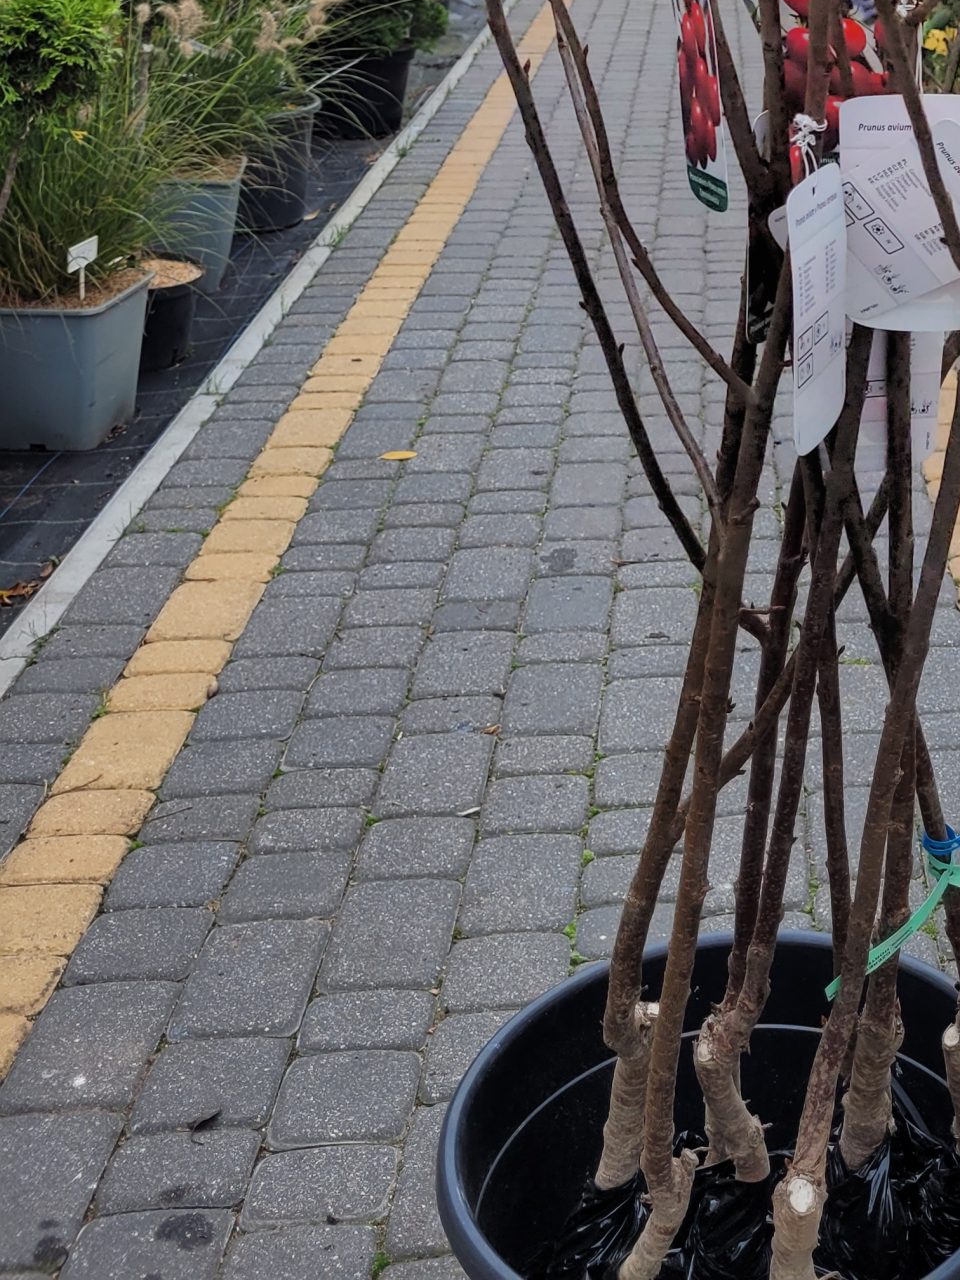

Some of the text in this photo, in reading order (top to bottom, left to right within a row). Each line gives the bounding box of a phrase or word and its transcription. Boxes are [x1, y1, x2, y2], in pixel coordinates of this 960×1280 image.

[858, 122, 912, 131] Prunus avium
[936, 141, 956, 165] Prunus
